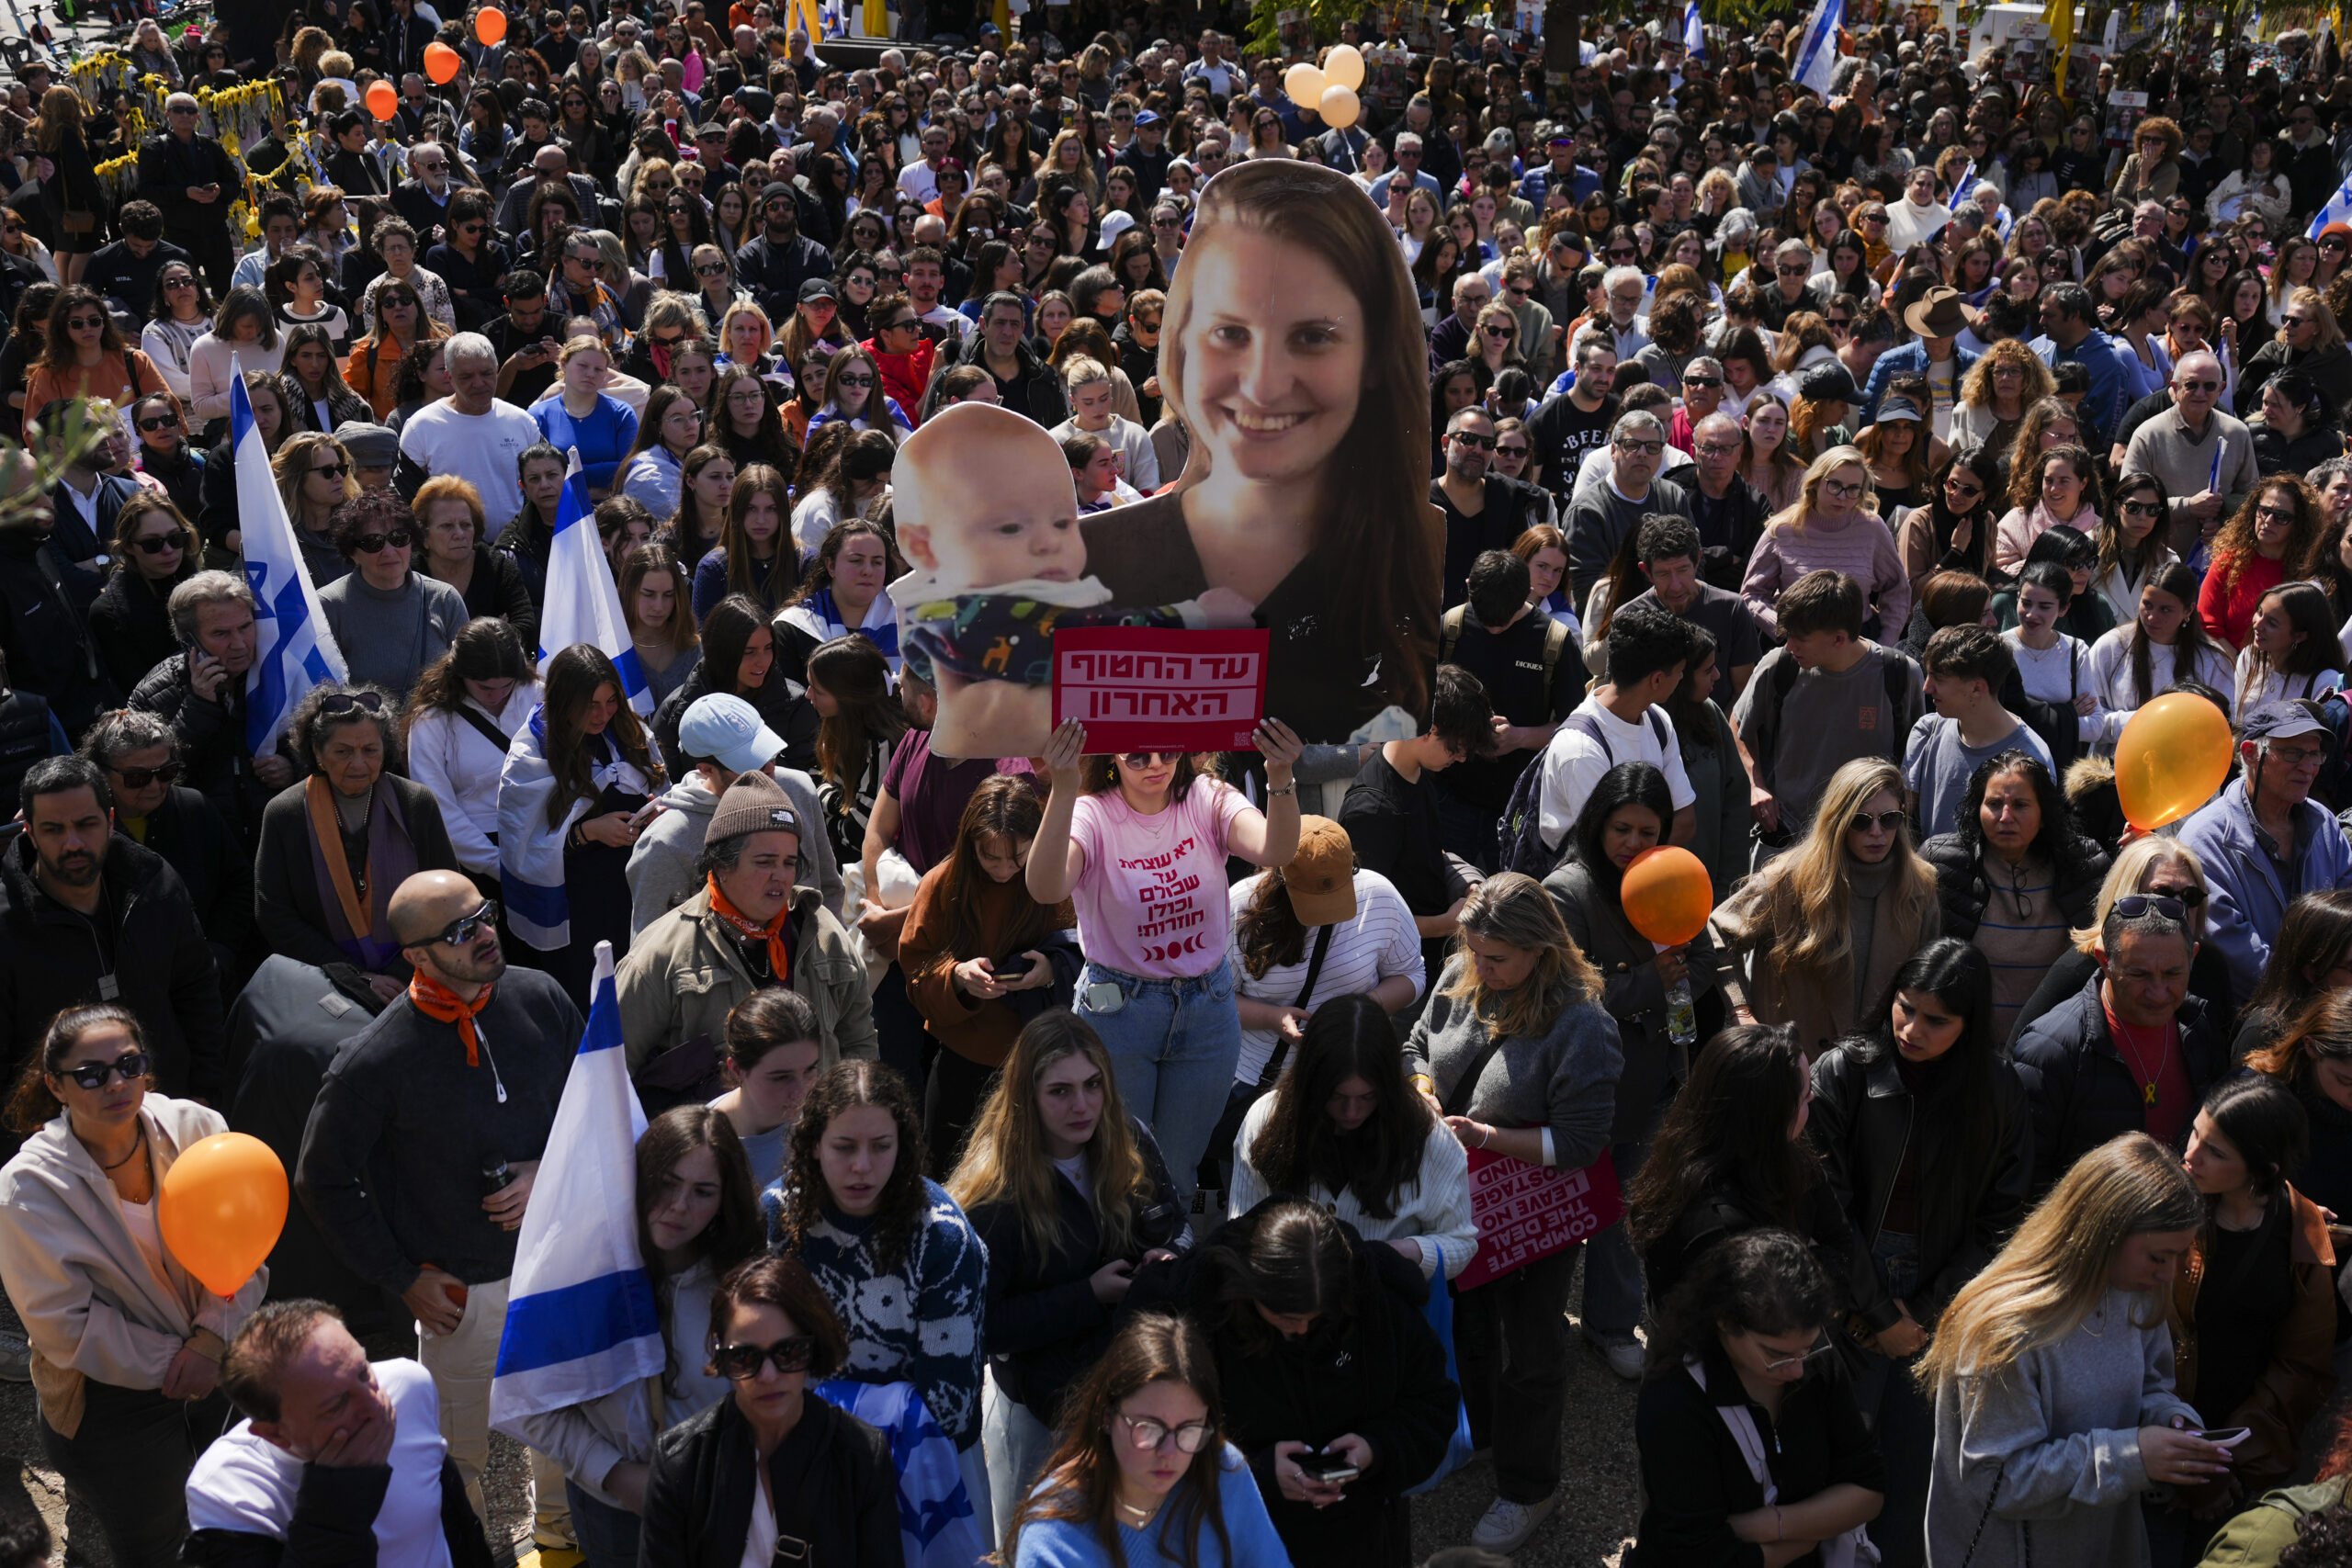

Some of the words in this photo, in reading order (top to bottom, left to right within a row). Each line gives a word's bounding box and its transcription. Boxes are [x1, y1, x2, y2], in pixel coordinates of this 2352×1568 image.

[1561, 456, 1577, 464] EST
[1070, 654, 1193, 682] החטוף
[1199, 657, 1250, 680] עד
[1515, 660, 1544, 671] DICKIES
[1089, 691, 1228, 718] האחרון
[1118, 852, 1172, 871] עוצרות
[1172, 837, 1195, 860] לא
[1139, 874, 1201, 903] שכולם
[1152, 869, 1178, 884] עד
[1148, 896, 1193, 922] וכולן
[1137, 909, 1204, 938] חוזרות!
[1473, 1168, 1567, 1213] OSTAGE
[1516, 1178, 1579, 1217] LEAVE
[1481, 1206, 1512, 1231] NO
[1544, 1198, 1589, 1229] THE
[1487, 1213, 1598, 1274] COMPLETE
[1488, 1217, 1542, 1250] DEAL
